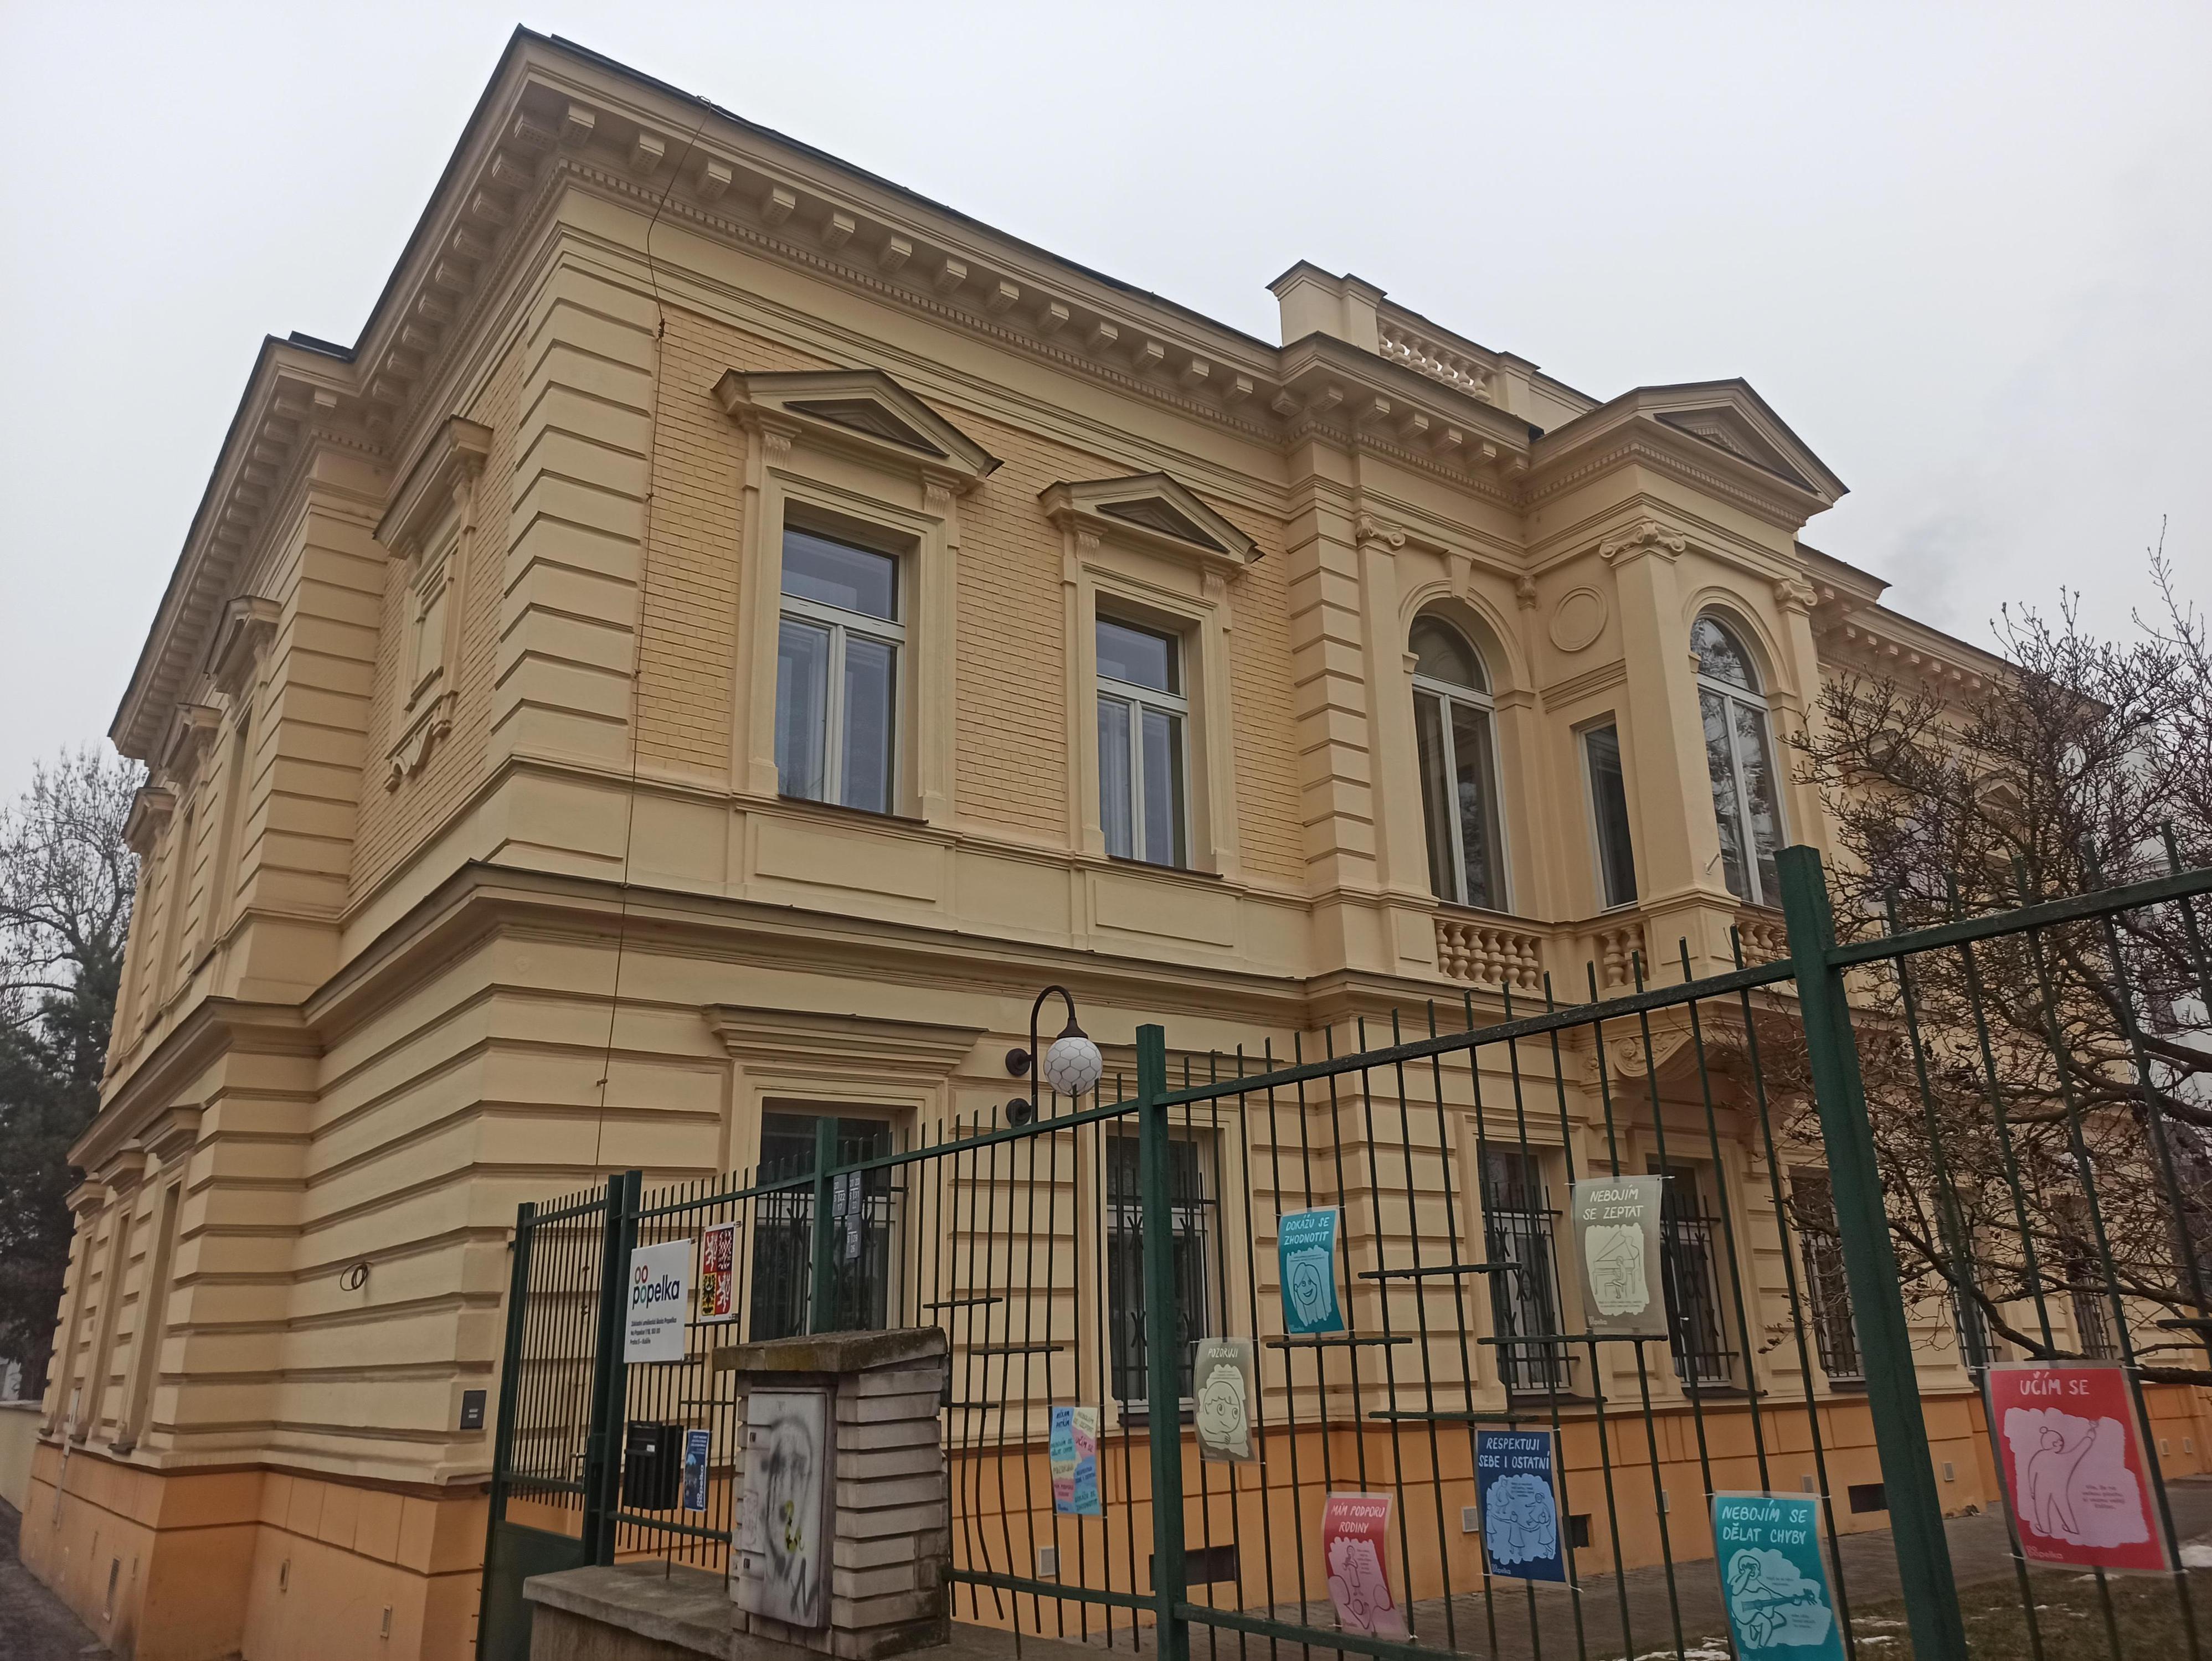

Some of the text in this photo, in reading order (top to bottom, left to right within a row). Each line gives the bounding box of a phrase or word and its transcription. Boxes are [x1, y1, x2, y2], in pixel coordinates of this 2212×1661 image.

[1589, 1184, 1639, 1202] NEBOJÍM
[1583, 1205, 1644, 1220] SE ZEPTAT
[1285, 1214, 1330, 1231] DOKÁŽU SE
[1284, 1231, 1329, 1246] ZHODNOTIT
[632, 1274, 680, 1310] popelka
[1207, 1348, 1238, 1358] POZORUJI
[2020, 1371, 2090, 1395] UČÍM SE
[1486, 1437, 1540, 1451] RESPEKTUJI
[1479, 1451, 1550, 1470] SEBE I OSTATNÍ
[1331, 1502, 1385, 1518] MÁM PODPORU
[1722, 1499, 1808, 1523] NEBOJÍM SE
[1339, 1521, 1369, 1534] RODINY
[1722, 1523, 1807, 1545] DĚLAT CHYBY
